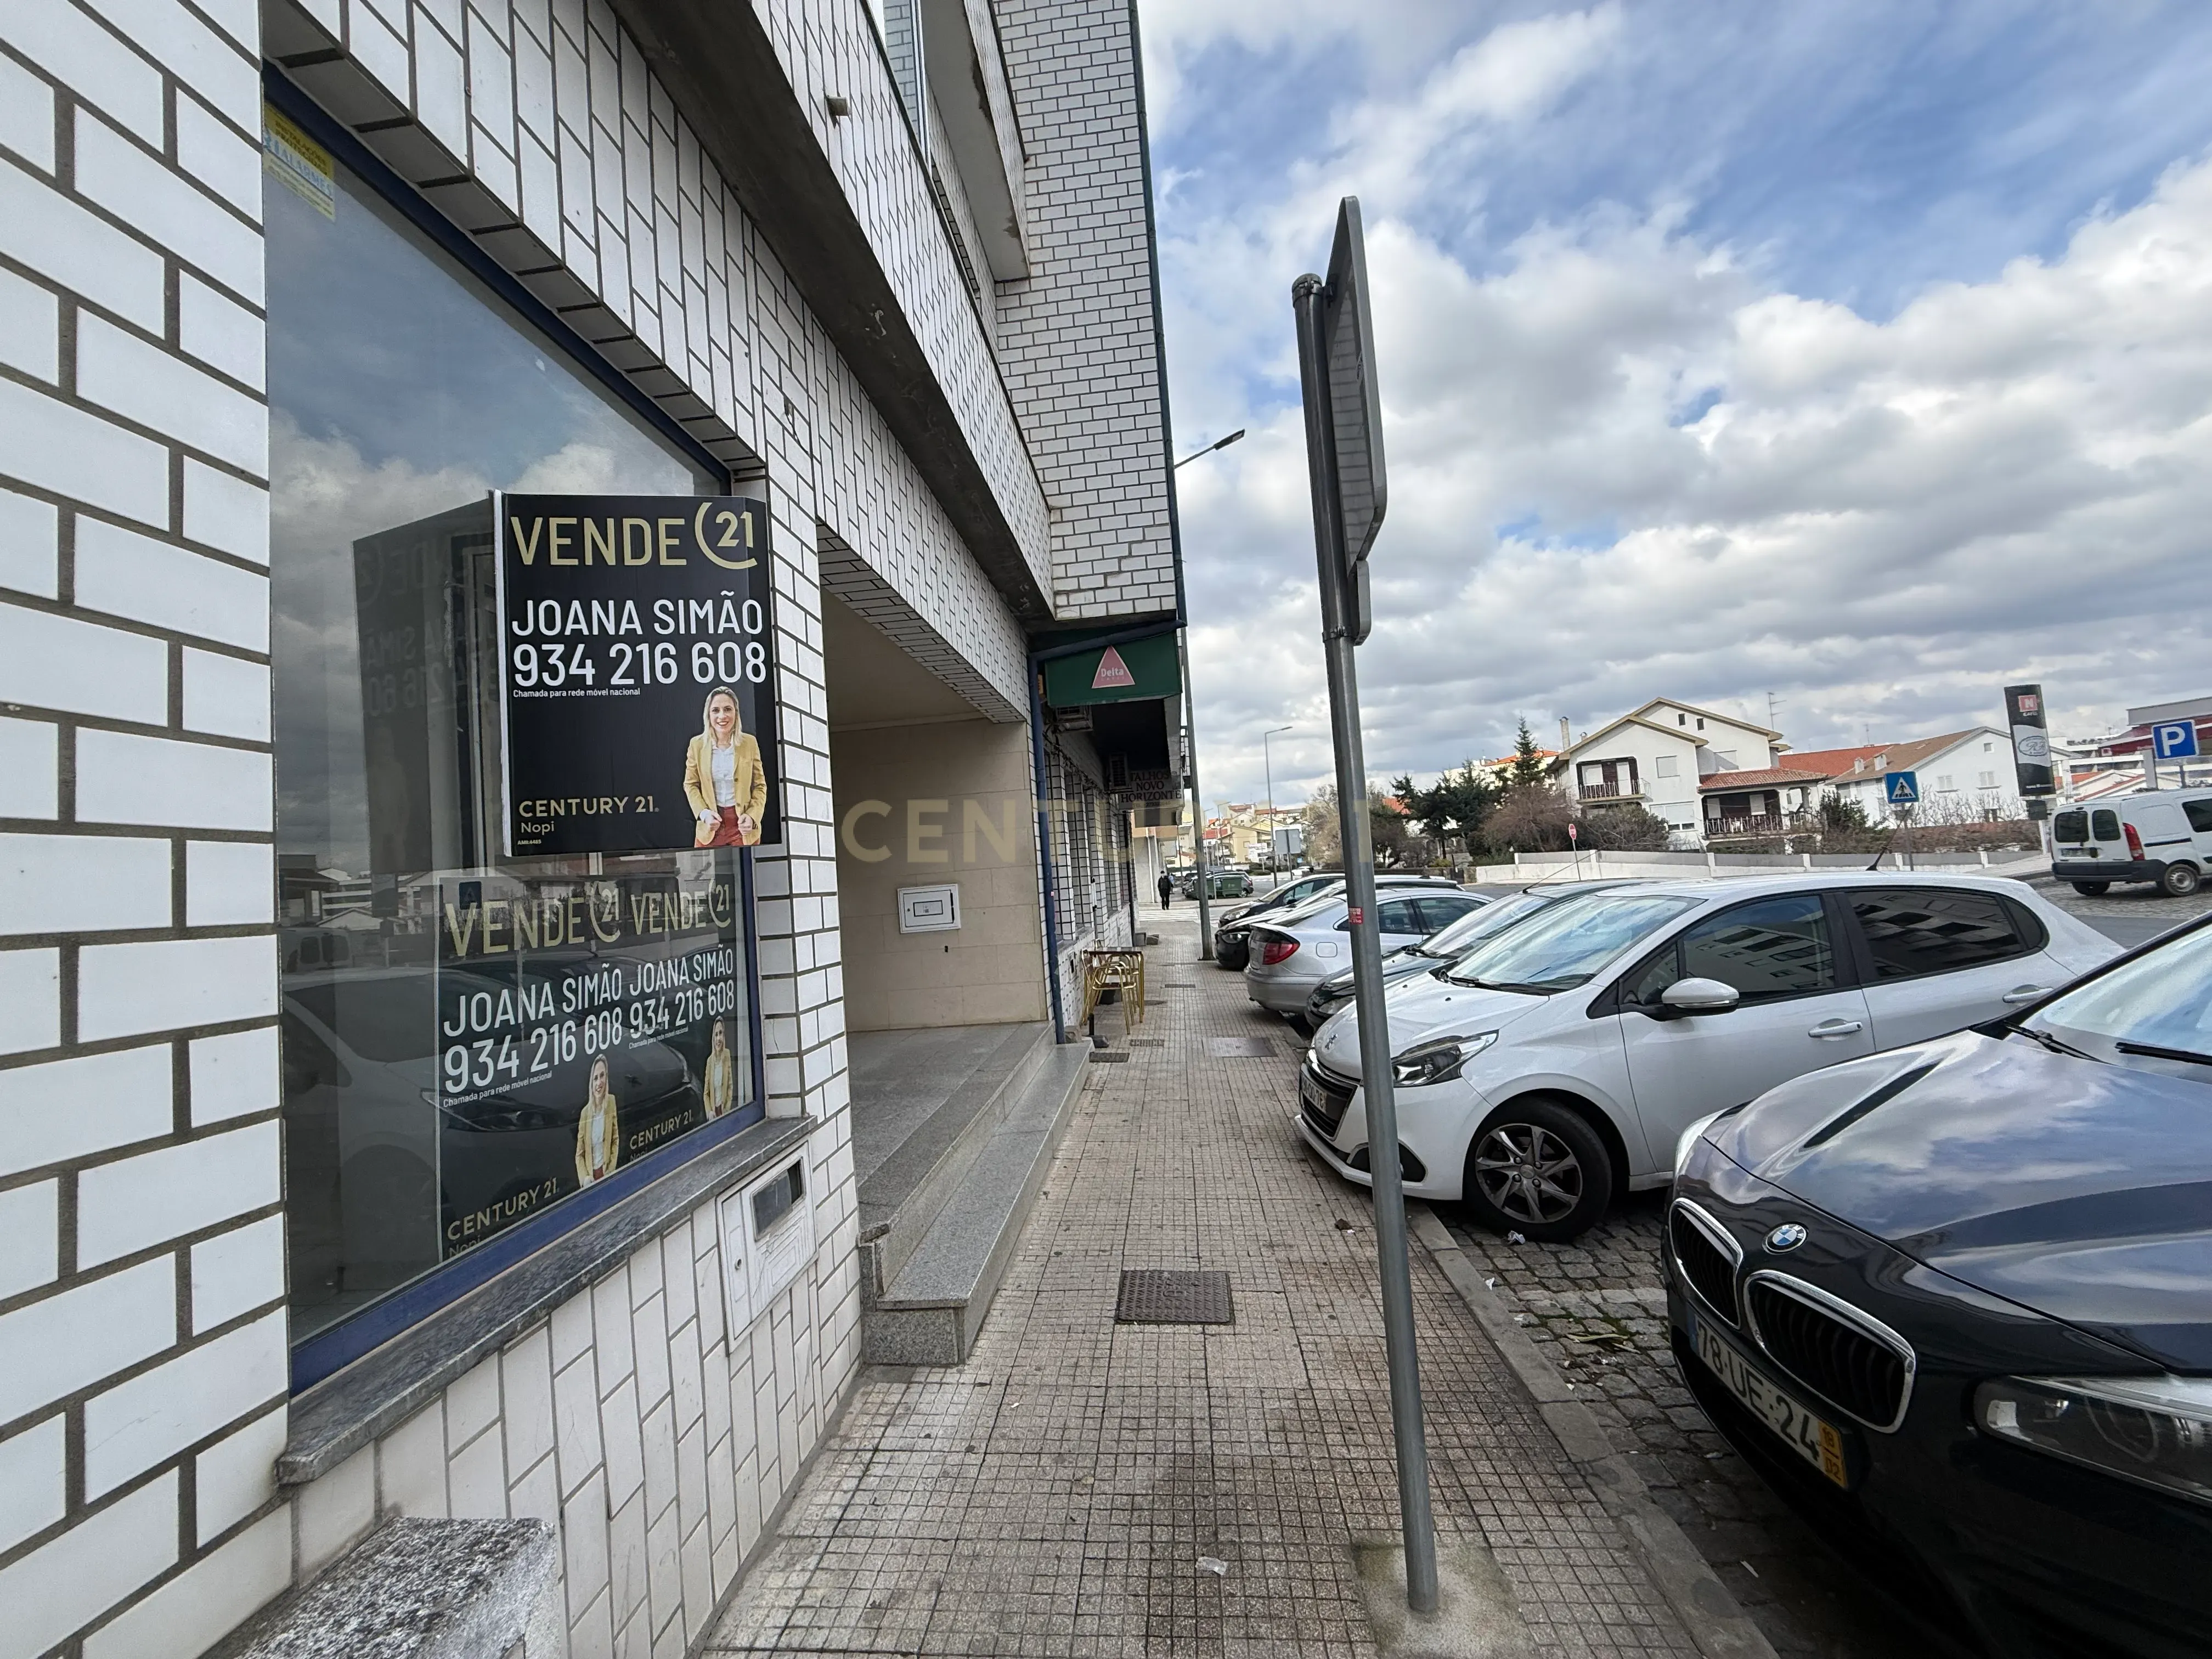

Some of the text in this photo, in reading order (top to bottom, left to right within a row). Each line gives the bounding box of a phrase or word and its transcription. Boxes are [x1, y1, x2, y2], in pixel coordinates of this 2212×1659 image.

[511, 517, 687, 567] VENDE
[512, 590, 763, 635] JOANA SIMÃO
[515, 641, 766, 687] 934 216 608
[1101, 667, 1124, 677] Delta
[513, 687, 640, 698] Chamada para rede móvel nacional
[2160, 726, 2186, 756] P
[519, 797, 629, 817] CENTURY
[1121, 790, 1182, 803] HORIZONTE
[1136, 781, 1164, 791] NOVO
[521, 821, 555, 836] Nopi
[445, 897, 585, 956] VENDE
[631, 891, 707, 935] VENDE
[630, 944, 733, 996] JOANA SIMÃO
[443, 963, 622, 1037] JOANA SIMÃO
[630, 979, 735, 1039] 934 216 608
[444, 1007, 622, 1093] 934 216 608
[443, 1070, 552, 1108] Chamada para rede móvel nacional
[629, 1114, 682, 1150] CENTURY
[447, 1183, 540, 1240] CENTURY
